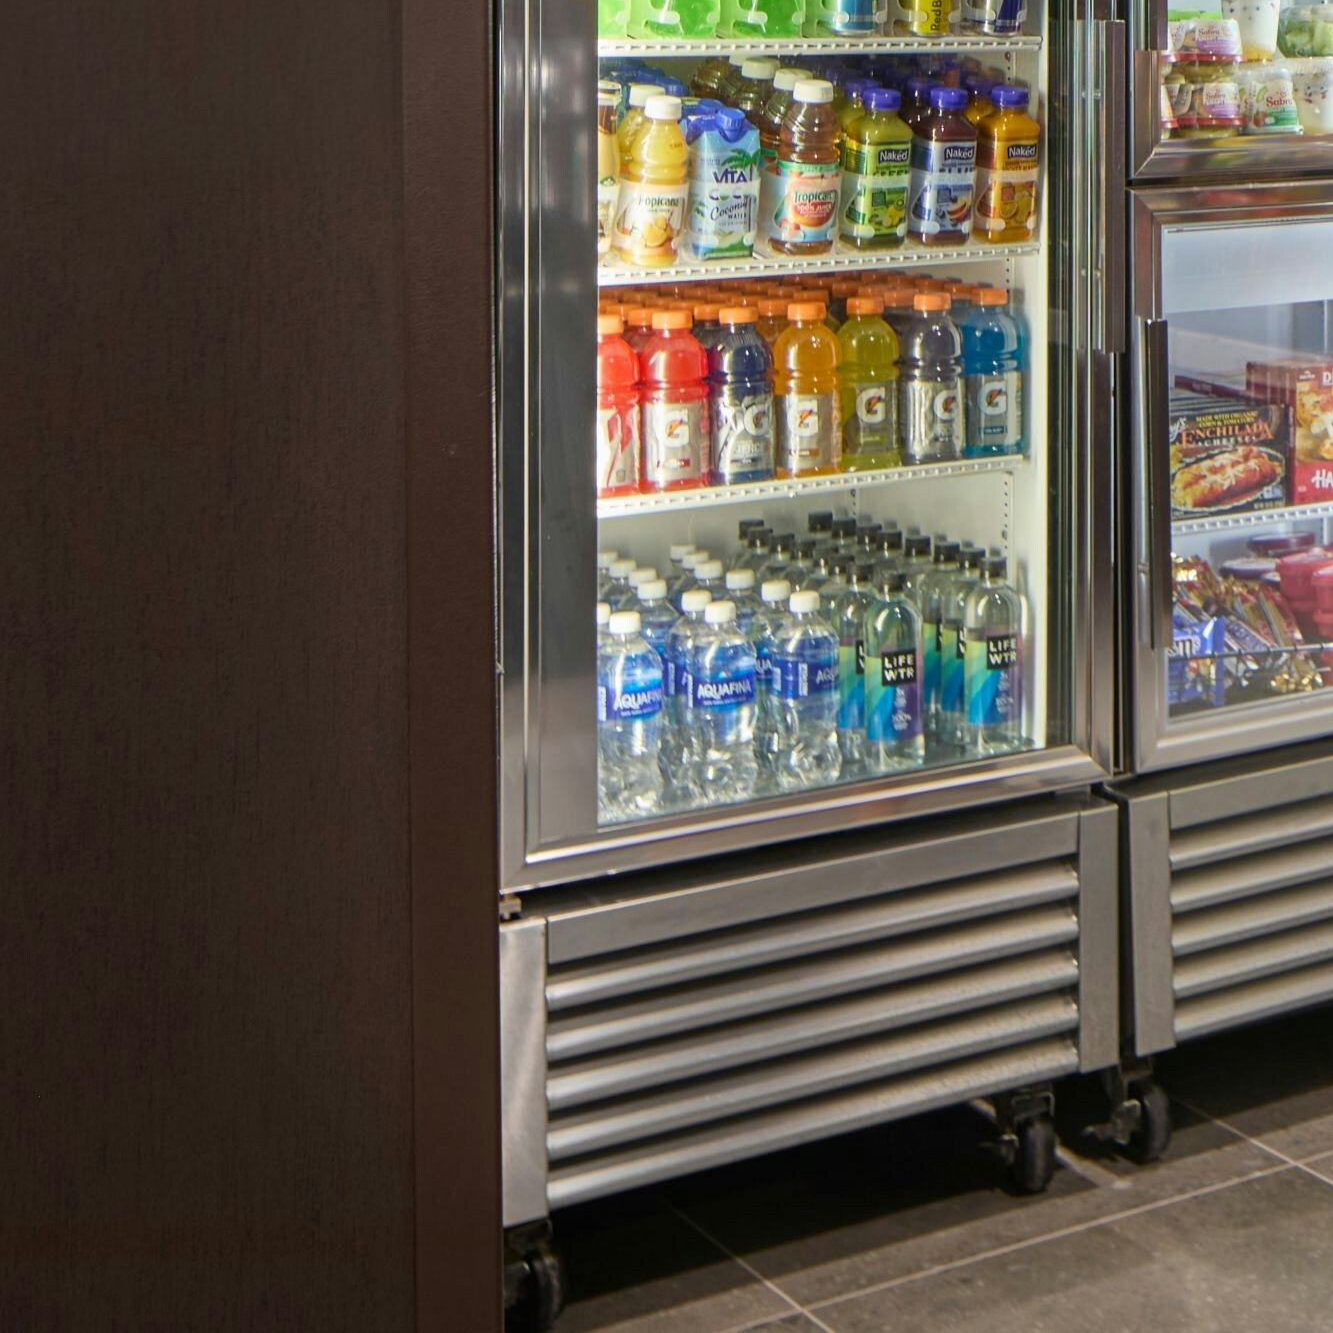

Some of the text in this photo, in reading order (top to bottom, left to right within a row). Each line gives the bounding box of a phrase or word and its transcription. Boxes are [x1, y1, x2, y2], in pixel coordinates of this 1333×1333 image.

[1265, 96, 1293, 107] Sabra
[712, 168, 748, 184] VITA
[1181, 420, 1275, 448] ENCHILADA
[989, 640, 1017, 653] LIFE
[884, 653, 915, 667] LIFE
[988, 652, 1017, 665] WTR
[883, 667, 915, 682] WTR
